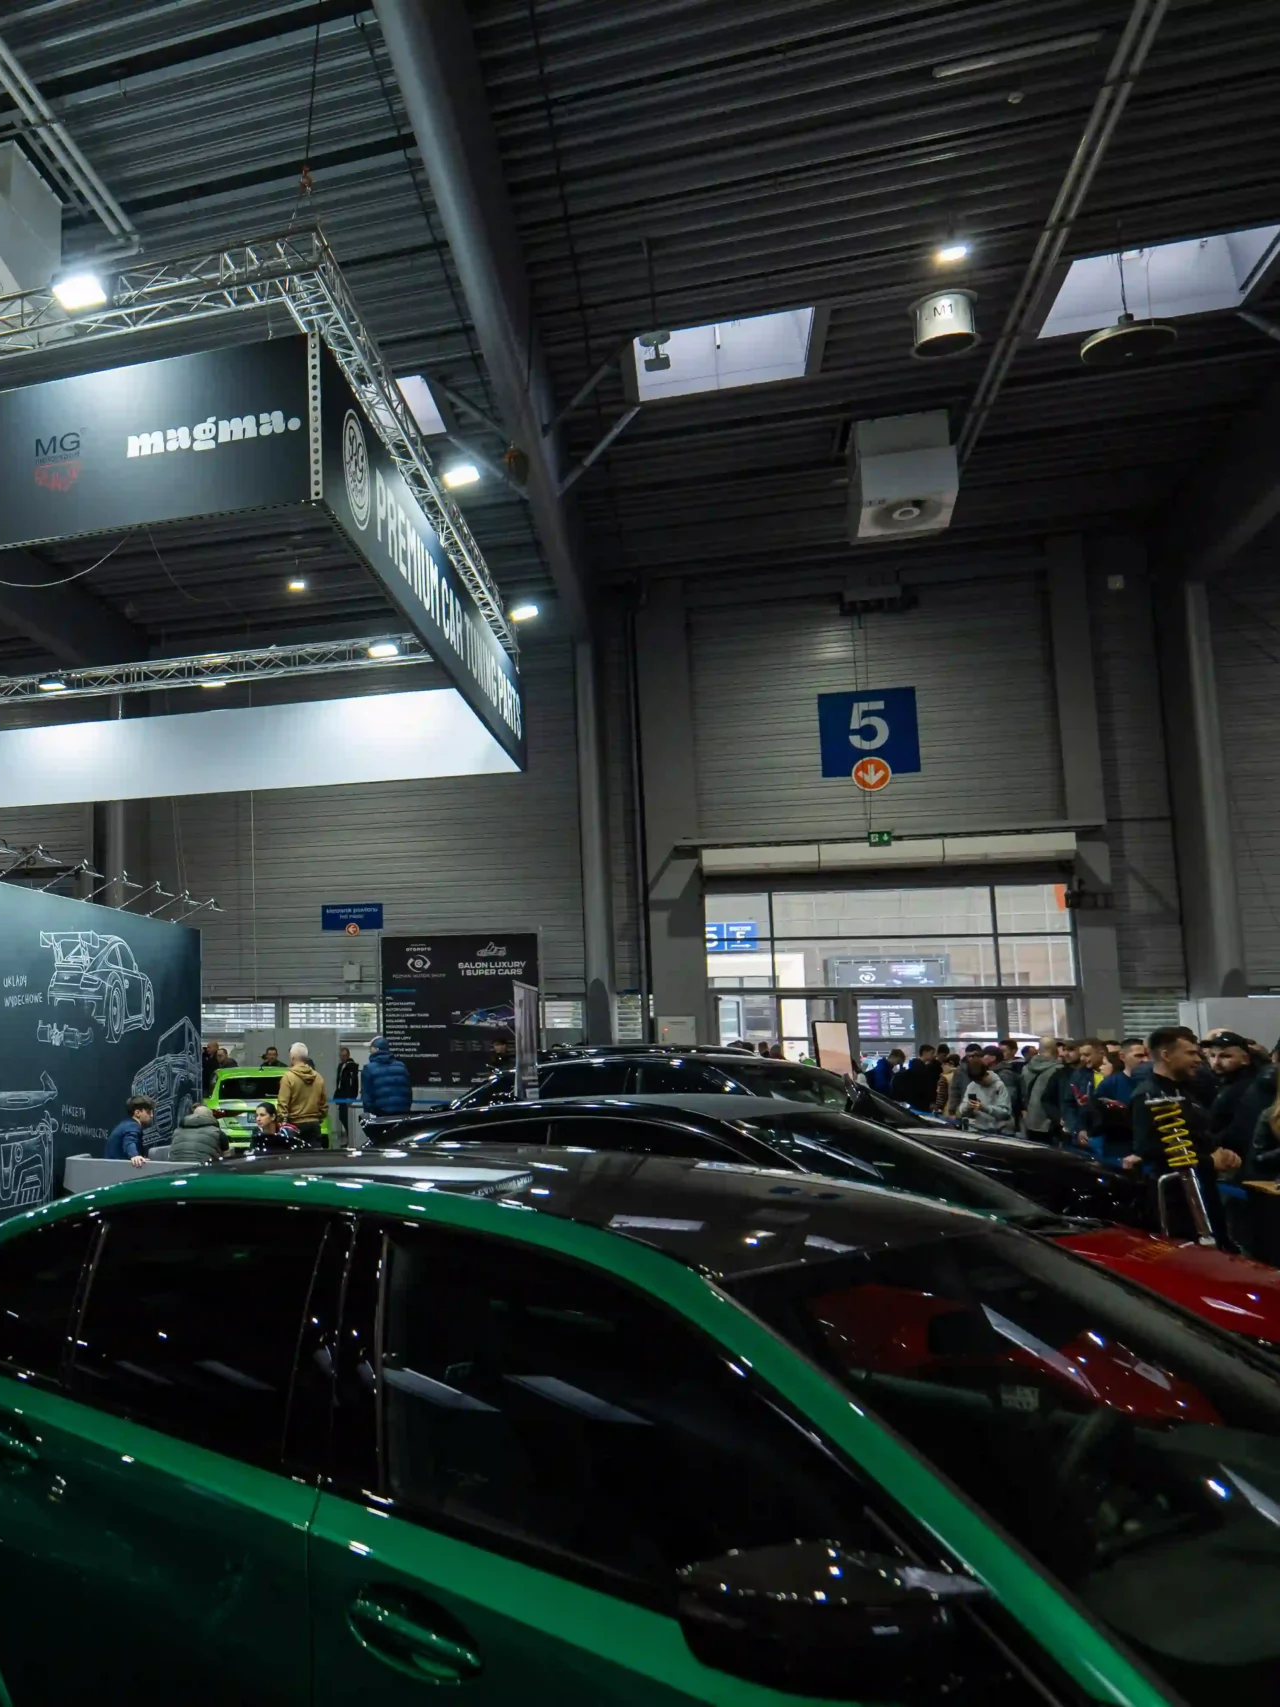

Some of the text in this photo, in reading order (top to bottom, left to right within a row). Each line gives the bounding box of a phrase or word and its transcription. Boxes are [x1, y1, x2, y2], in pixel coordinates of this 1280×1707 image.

[933, 303, 953, 317] M1
[35, 432, 80, 457] MG
[375, 467, 522, 741] PREMIUM CAR TUNING PARTS
[848, 700, 890, 750] 5
[458, 960, 526, 970] SALON LUXURY
[498, 968, 523, 976] CARS
[4, 992, 43, 1008] WYDECHOWE
[61, 1104, 86, 1120] PAKIETY
